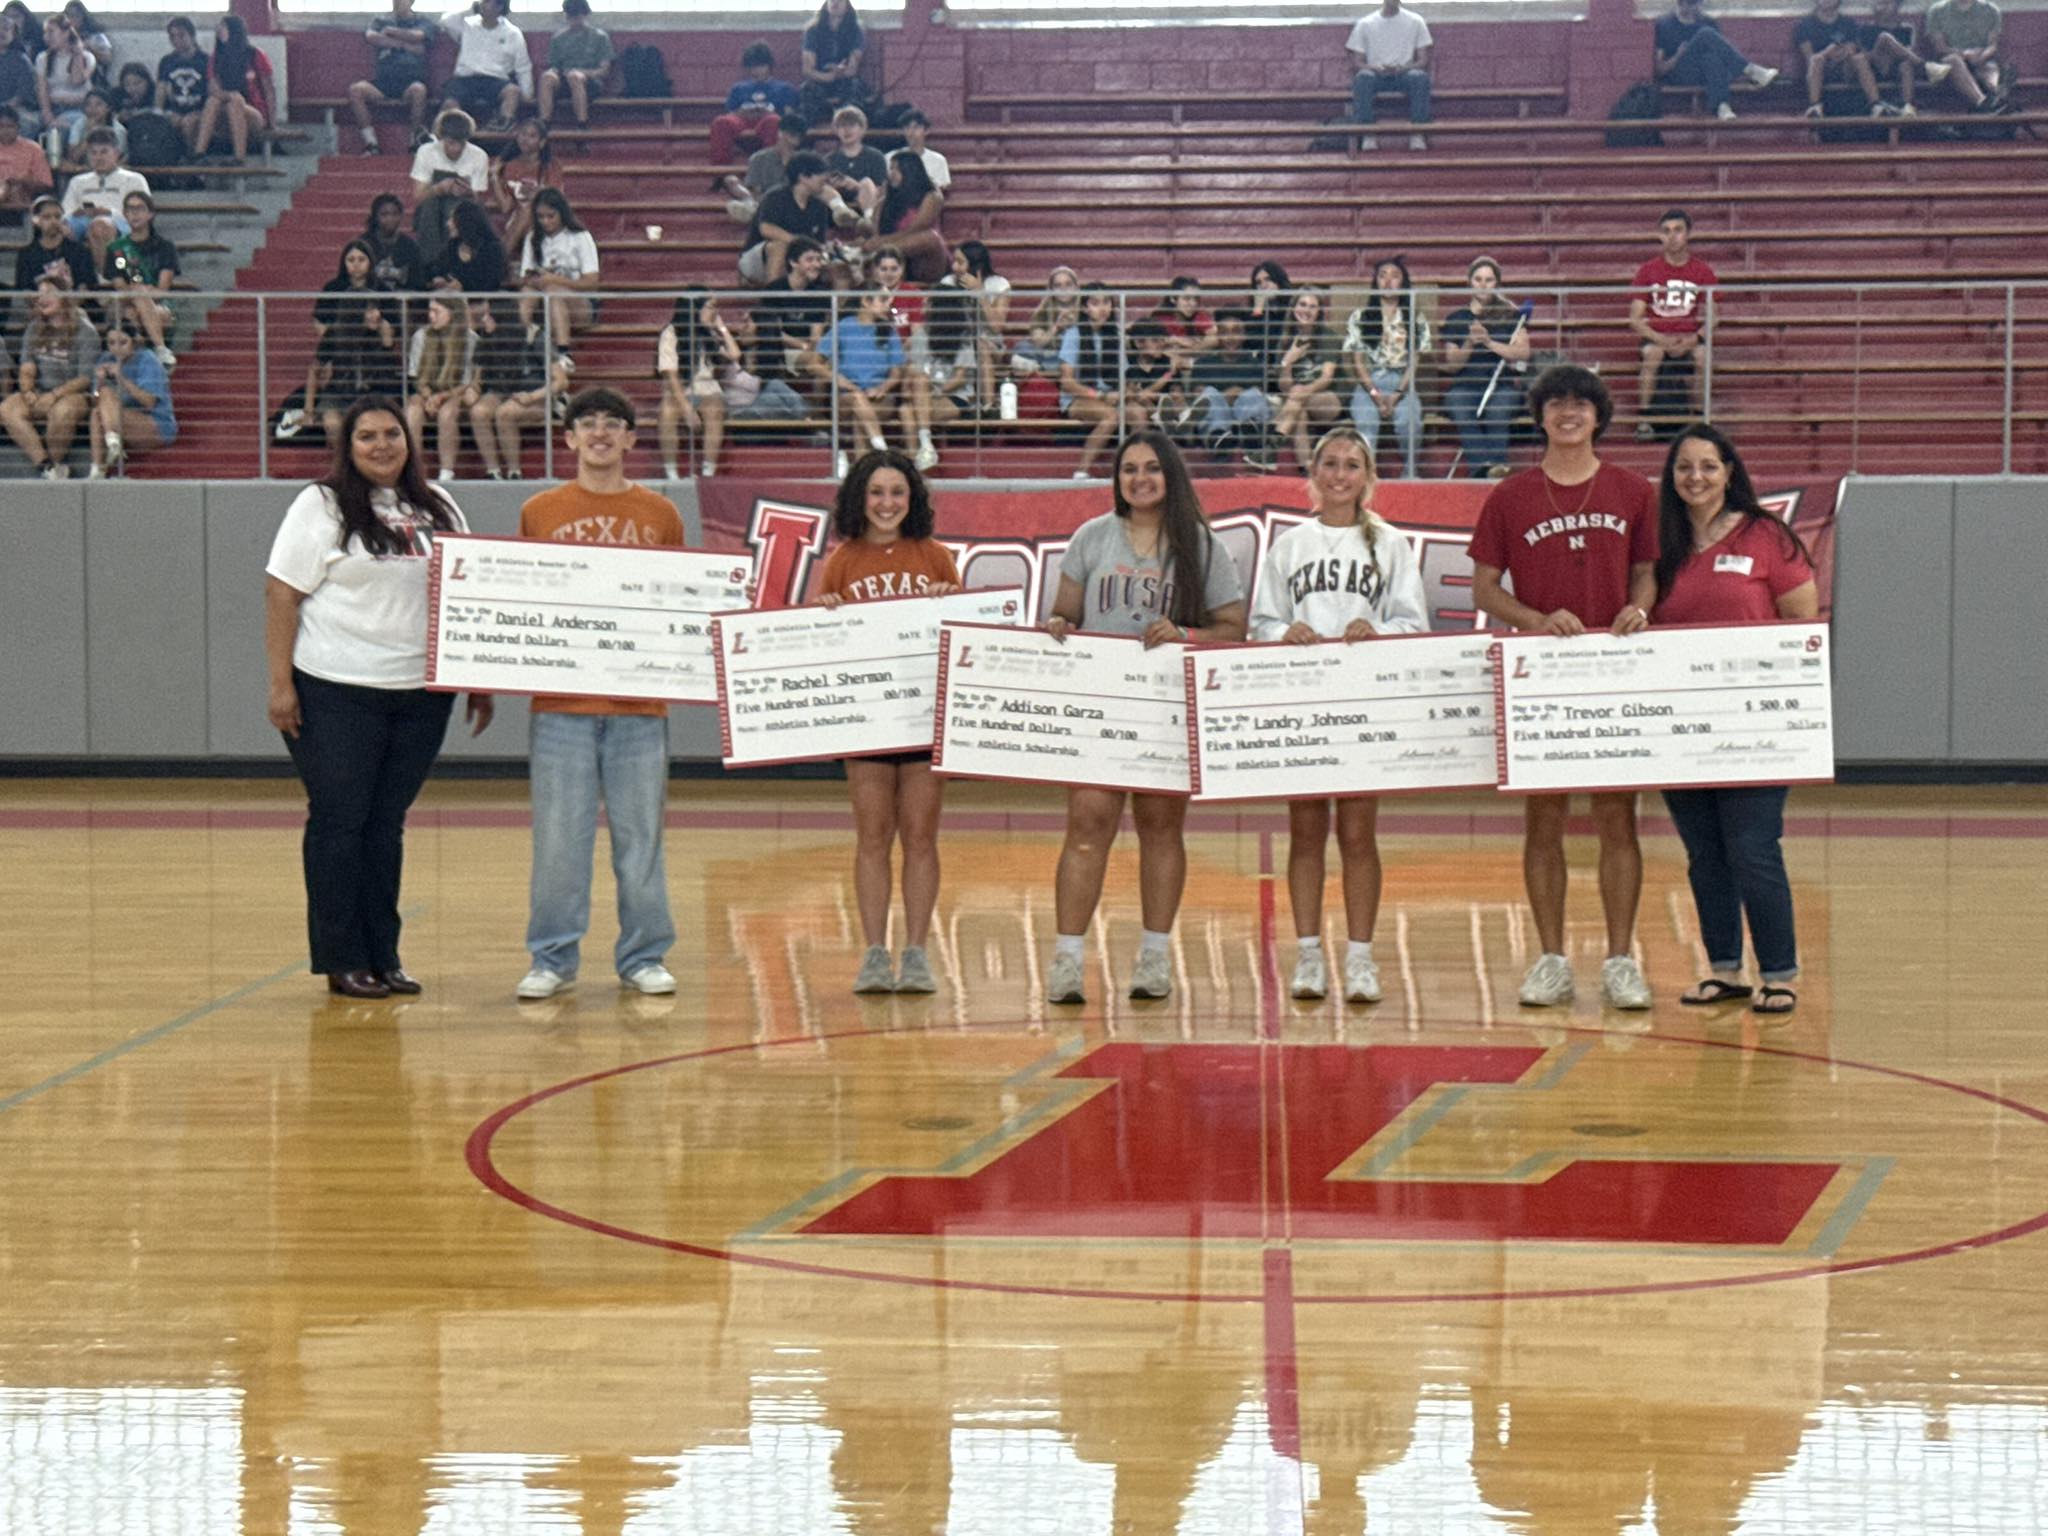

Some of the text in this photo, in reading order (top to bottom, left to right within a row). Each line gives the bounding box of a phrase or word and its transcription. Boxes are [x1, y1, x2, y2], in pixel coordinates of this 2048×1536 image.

[1524, 512, 1628, 547] NEBRASKA
[1568, 535, 1586, 551] N
[450, 557, 468, 580] L
[621, 583, 643, 592] DATE
[849, 571, 930, 600] TEXAS
[1287, 558, 1341, 606] TEXAS
[496, 611, 617, 632] Daniel Anderson
[445, 630, 635, 651] Five Hundred Dollars 00/100
[730, 630, 747, 654] L
[899, 631, 921, 640] DATE
[520, 655, 575, 669] Scholarship
[957, 644, 974, 667] L
[1512, 655, 1530, 678] L
[1690, 663, 1714, 672] DATE
[782, 670, 892, 691] Rachel Sherman
[1125, 673, 1147, 683] DATE
[1203, 667, 1221, 691] L
[1376, 673, 1398, 682] DATE
[735, 687, 921, 715] Five Hundred Dollars 00/100
[1000, 699, 1104, 720] Addison Garza
[1759, 698, 1799, 711] 500.00
[811, 714, 865, 729] Scholarship
[1254, 711, 1367, 731] Landry Johnson
[1564, 703, 1673, 720] Trevor Gibson
[952, 715, 1138, 740] Five Hundred Dollars 00/100
[1513, 730, 1540, 742] Five
[1544, 727, 1590, 740] Hundred
[1595, 725, 1641, 738] Dollars
[1671, 722, 1711, 735] 00/100
[1024, 742, 1079, 757] Scholarship
[1206, 740, 1231, 752] Five
[1236, 737, 1280, 751] Hundred
[1285, 734, 1329, 748] Dollars
[1358, 730, 1396, 743] 00/100
[1283, 756, 1339, 770] Scholarship
[1593, 747, 1651, 761] Scholarship
